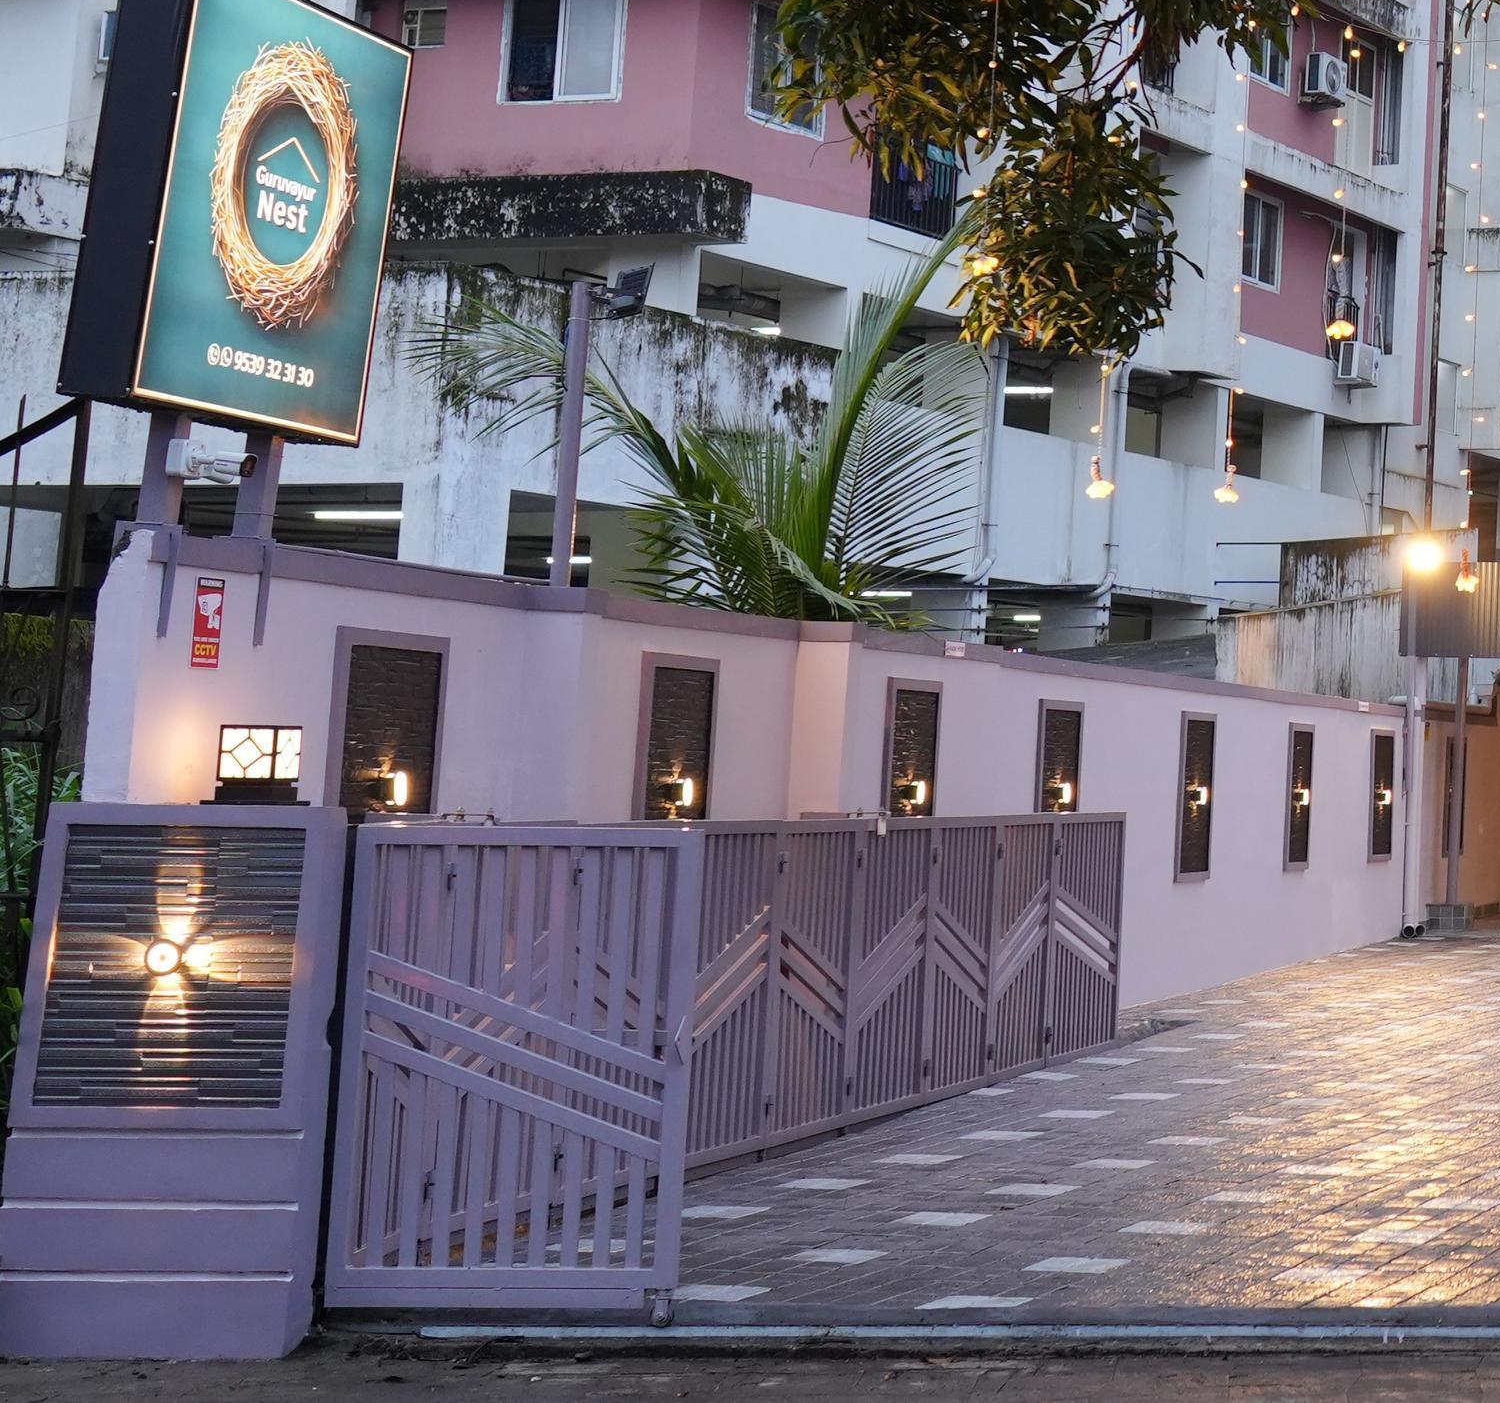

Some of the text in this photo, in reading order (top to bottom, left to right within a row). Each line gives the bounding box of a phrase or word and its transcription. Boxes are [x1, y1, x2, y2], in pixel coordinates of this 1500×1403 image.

[255, 165, 317, 201] Guruvayur
[256, 190, 309, 233] Nest
[233, 350, 315, 387] 9539 32 31 30
[194, 643, 217, 655] CCTV
